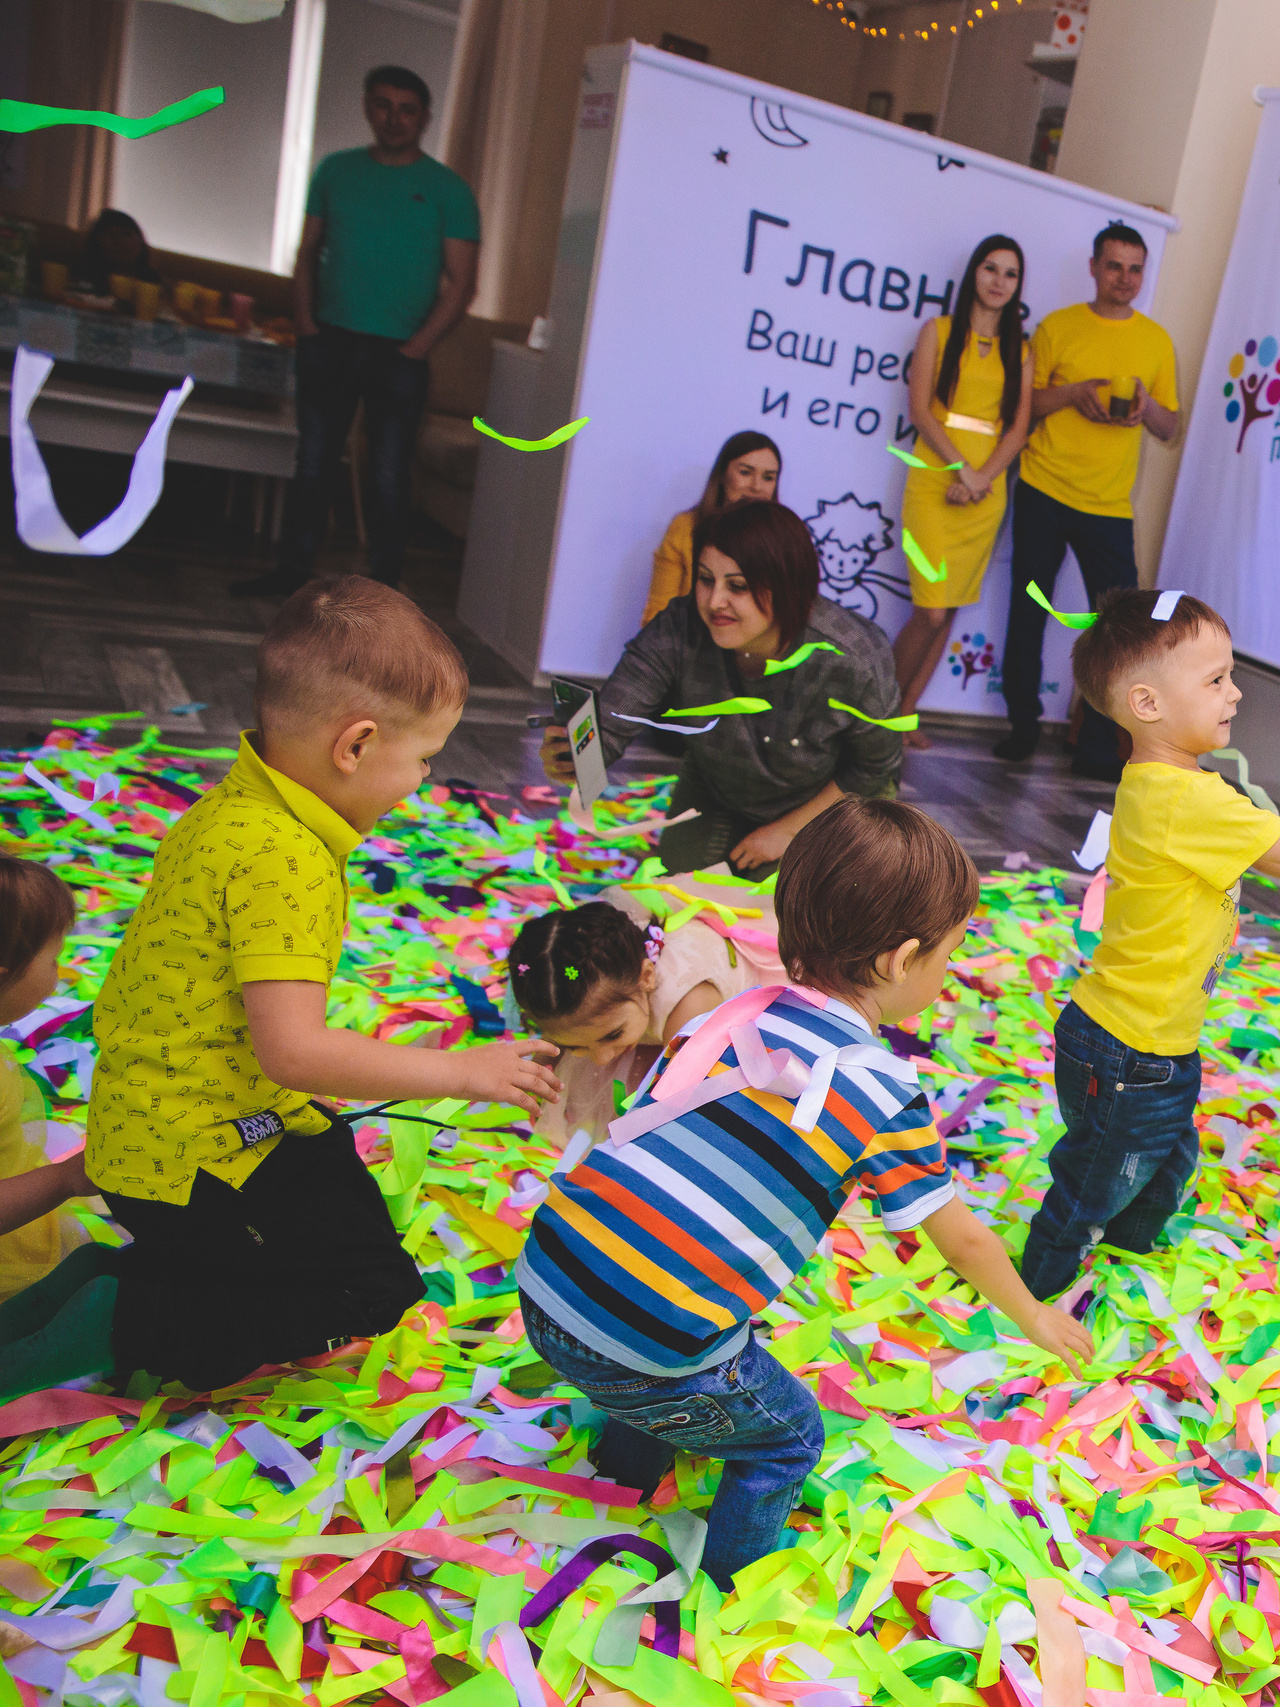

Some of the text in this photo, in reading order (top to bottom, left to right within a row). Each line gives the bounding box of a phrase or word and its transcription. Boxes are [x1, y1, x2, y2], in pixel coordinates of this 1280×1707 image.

[744, 209, 1030, 321] Главн
[746, 308, 837, 367] Ваш
[762, 386, 790, 419] и
[807, 397, 880, 436] его
[244, 1115, 281, 1146] SOME
